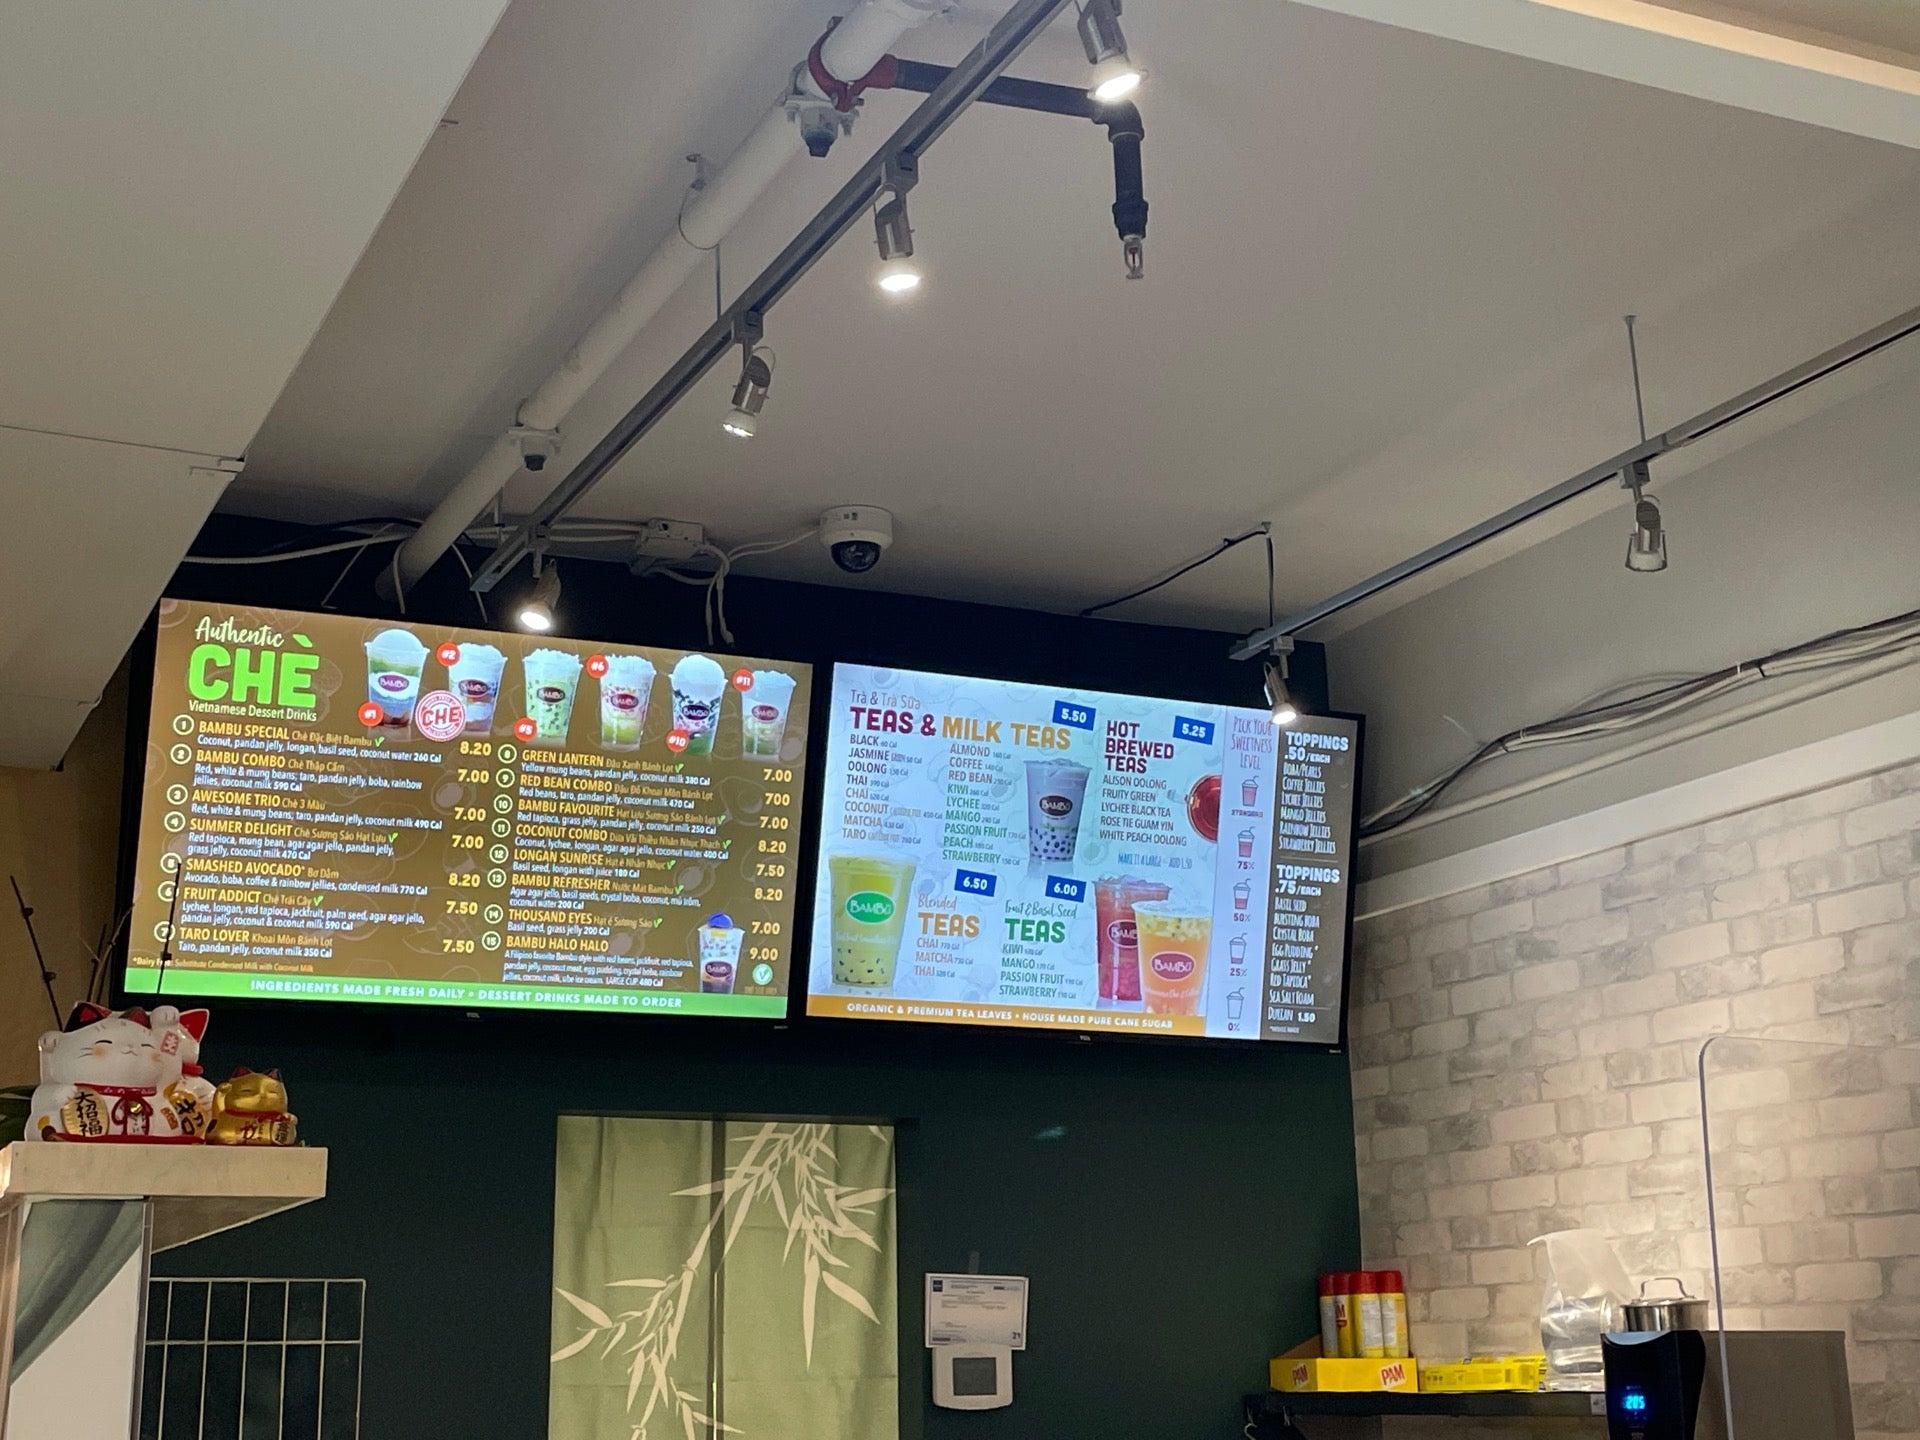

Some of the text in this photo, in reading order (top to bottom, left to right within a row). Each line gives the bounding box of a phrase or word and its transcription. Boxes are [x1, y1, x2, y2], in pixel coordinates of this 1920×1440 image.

[194, 612, 285, 648] Authentic
[187, 624, 321, 709] CHÈ
[851, 689, 867, 704] Trà
[870, 691, 878, 705] &
[881, 692, 897, 707] Trà
[187, 699, 317, 721] Vietnamese Dessert Drinks
[1061, 708, 1086, 723] 5.50
[198, 721, 289, 739] BAMBU SPECIAL
[848, 706, 1071, 750] TEAS & MILK TEAS
[1106, 720, 1139, 738] HOT
[1181, 723, 1205, 737] 5.25
[849, 734, 879, 746] BLACK
[1231, 734, 1272, 753] SWEETNESS
[1285, 731, 1348, 750] TOPPINGS
[459, 741, 491, 755] 8.20
[848, 747, 889, 760] JASMINE
[950, 743, 990, 756] ALMOND
[1105, 738, 1174, 759] BREWED
[196, 749, 285, 767] BAMBU COMBO
[522, 750, 603, 766] GREEN LANTERN
[949, 757, 982, 769] COFFEE
[1103, 755, 1147, 774] TEAS
[1240, 753, 1261, 769] LEVEL
[847, 761, 886, 774] OOLONG
[456, 768, 489, 783] 7.00
[762, 768, 792, 782] 7.00
[846, 774, 867, 785] THAI
[948, 770, 992, 783] RED BEAN
[520, 774, 612, 791] RED BEAN COMBO
[947, 783, 968, 794] KIWI
[1133, 777, 1166, 789] OOLONG
[192, 789, 280, 806] AWESOME TRIO
[764, 792, 790, 805] 700
[845, 787, 868, 799] CHAI
[1102, 789, 1156, 801] FRUITY GREEN
[518, 799, 614, 816] BAMBU FAVOURITE
[844, 801, 888, 814] COCONUT
[946, 796, 979, 808] LYCHEE
[453, 806, 486, 821] 7.00
[945, 810, 980, 822] MANGO
[1101, 802, 1171, 817] LYCHEE BLACK TEA
[189, 818, 292, 836] SUMMER DELIGHT
[759, 816, 788, 829] 7.00
[844, 814, 882, 827] MATCHA
[1100, 816, 1120, 826] ROSE
[1122, 817, 1133, 827] TIE
[1160, 820, 1173, 830] YIN
[516, 824, 607, 840] COCONUT COMBO
[843, 828, 866, 839] TARO
[944, 823, 1007, 837] PASSION FRUIT
[451, 834, 484, 848] 7.00
[943, 836, 973, 848] PEACH
[1099, 829, 1186, 846] WHITE PEACH OOLONG
[757, 840, 786, 853] 8.20
[514, 849, 603, 865] LONGAN SUNRISE
[942, 850, 1000, 863] STRAWBERRY
[185, 858, 242, 873] SMASHED
[755, 863, 784, 876] 7.50
[1237, 861, 1254, 869] 75%
[448, 872, 480, 886] 8.20
[1276, 864, 1340, 883] TOPPINGS
[512, 874, 610, 890] BAMBU REFRESHER
[963, 876, 987, 890] 6.50
[1053, 882, 1077, 896] 6.00
[183, 887, 261, 902] FRUIT ADDICT
[754, 887, 783, 900] 8.20
[446, 900, 478, 914] 7.50
[918, 893, 957, 910] Blended
[508, 909, 592, 924] THOUSAND EYES
[1233, 912, 1250, 921] 50%
[751, 921, 780, 934] 7.00
[916, 911, 980, 938] TEAS
[1003, 917, 1065, 943] TEAS
[179, 927, 249, 942] TARO LOVER
[178, 941, 332, 956] Taro, pandan jelly, coconut milk 350 Cal
[442, 939, 475, 953] 7.50
[506, 935, 608, 951] BAMBU HALO HALO
[916, 938, 938, 948] CHAI
[1002, 943, 1023, 954] KIWI
[749, 947, 778, 960] 9.00
[915, 951, 953, 963] MATCHA
[1001, 957, 1035, 969] MANGO
[913, 965, 935, 976] THAI
[1000, 971, 1064, 984] PASSION FRUIT
[1230, 968, 1246, 976] 25%
[250, 980, 681, 1006] INGREDIENTS MADE FRESH DAILY DESSERT DRINKS MADE TO ORDER
[999, 985, 1056, 997] STRAWBERRY
[847, 1003, 1173, 1028] ORGANIC & PREMIUM TEA LEAVES HOUSE MADE PURE CANE SUGAR
[1297, 1012, 1315, 1022] 1.50
[1227, 1023, 1239, 1031] 0%
[75, 1091, 102, 1136] 大招福
[1291, 1363, 1308, 1385] PAM
[1381, 1363, 1405, 1386] PAM
